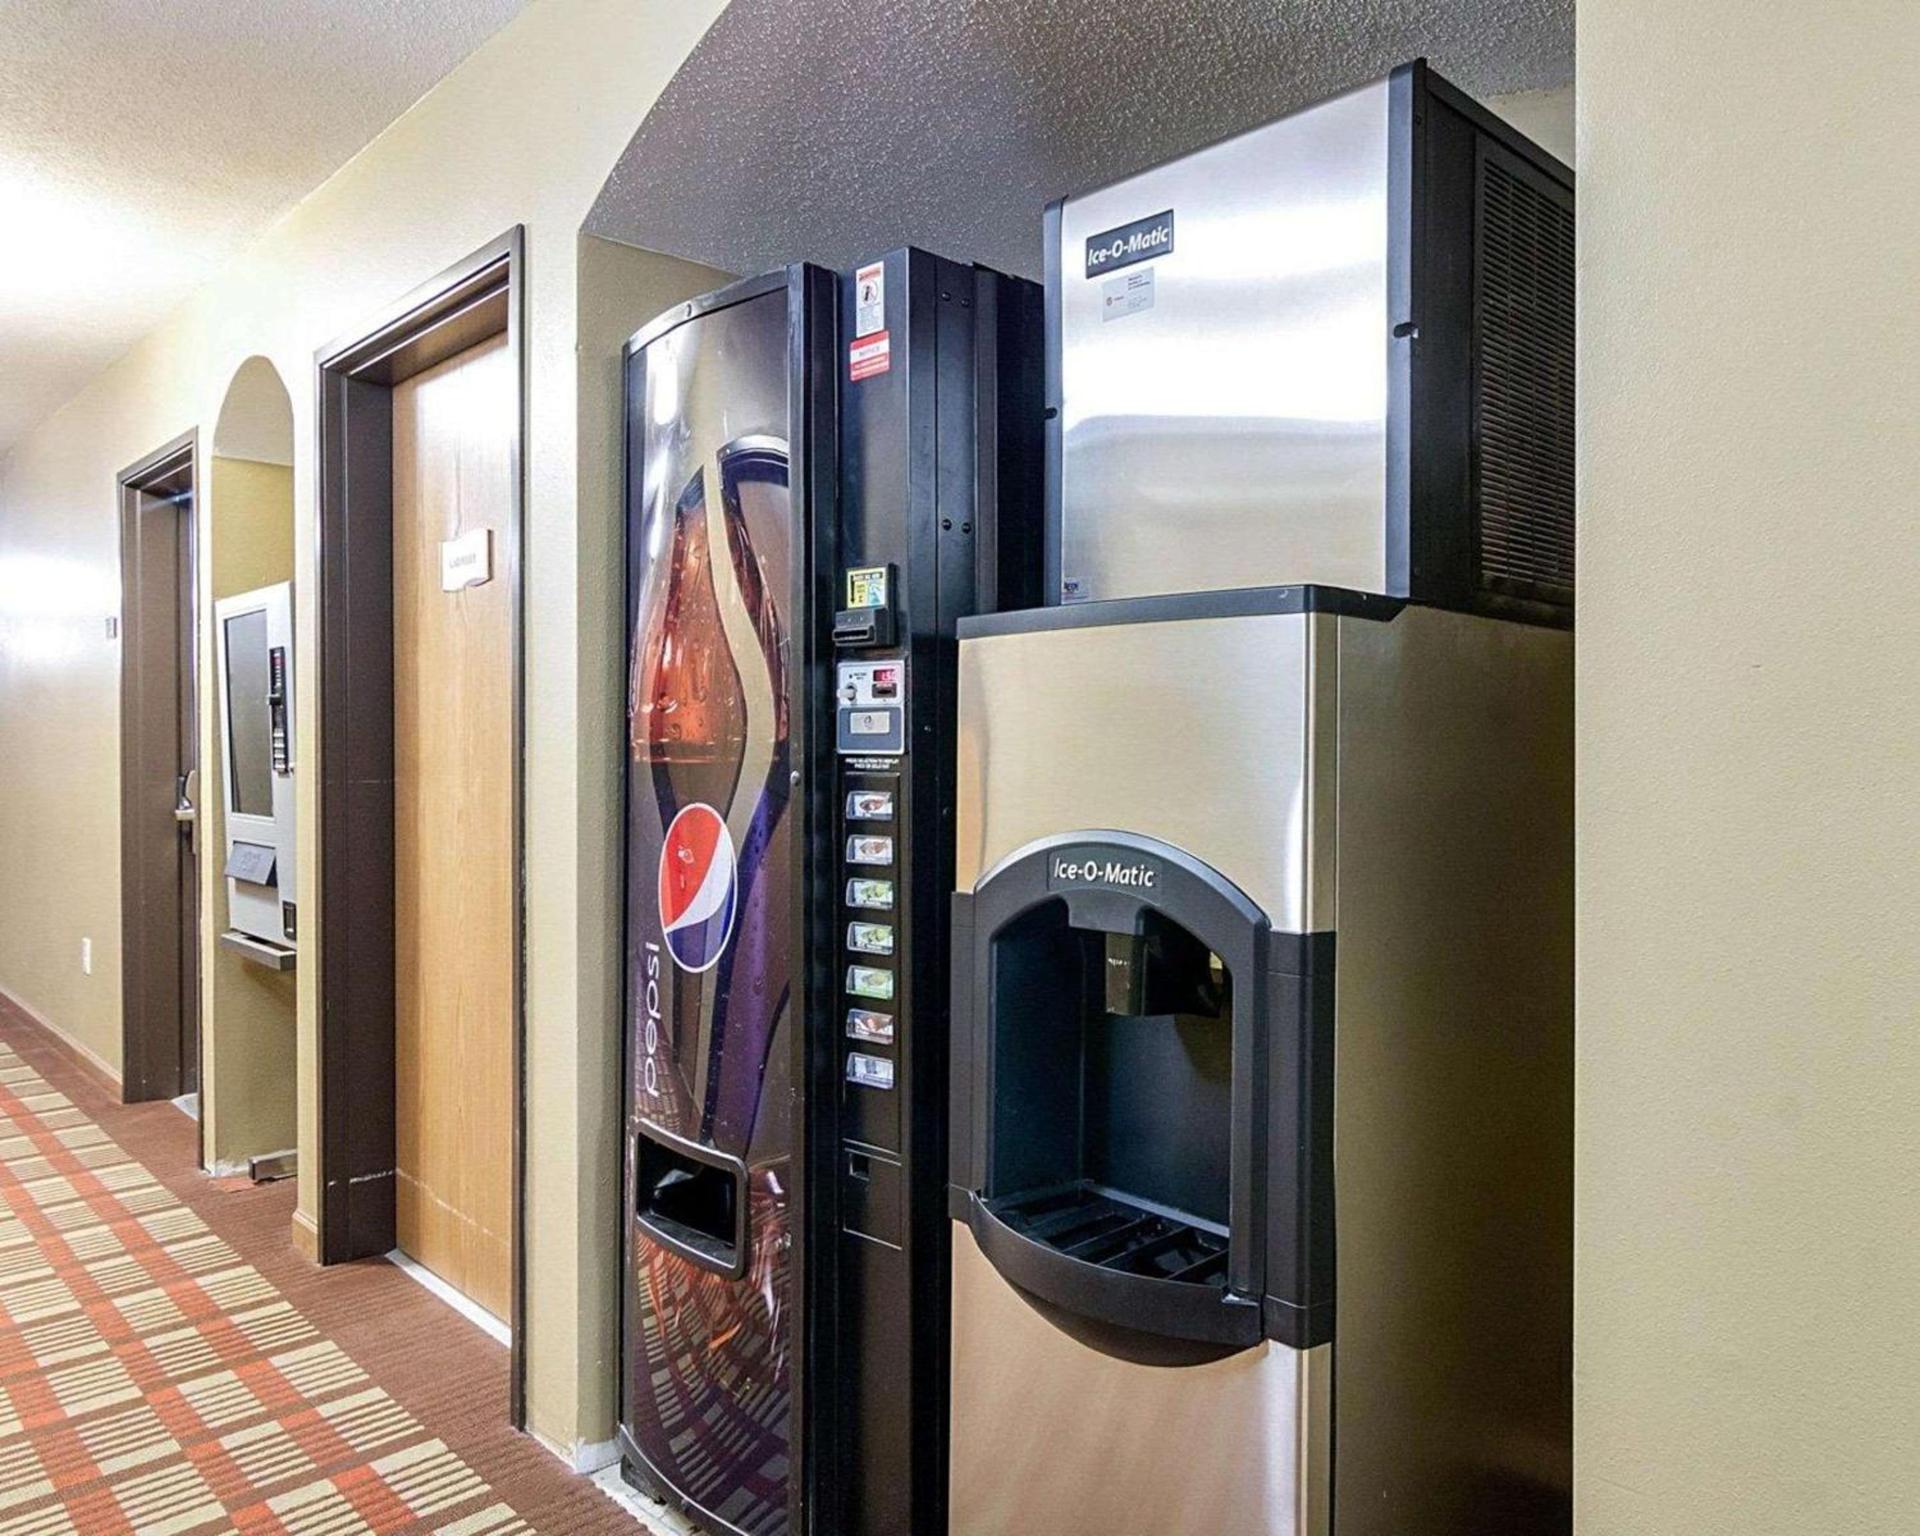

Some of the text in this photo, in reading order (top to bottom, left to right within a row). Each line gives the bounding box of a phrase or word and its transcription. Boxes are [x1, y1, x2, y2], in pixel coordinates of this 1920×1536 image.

[1087, 226, 1168, 266] Ice-O-Matic
[1054, 858, 1154, 887] Ice-O-Matic
[645, 942, 661, 1097] pepsi
